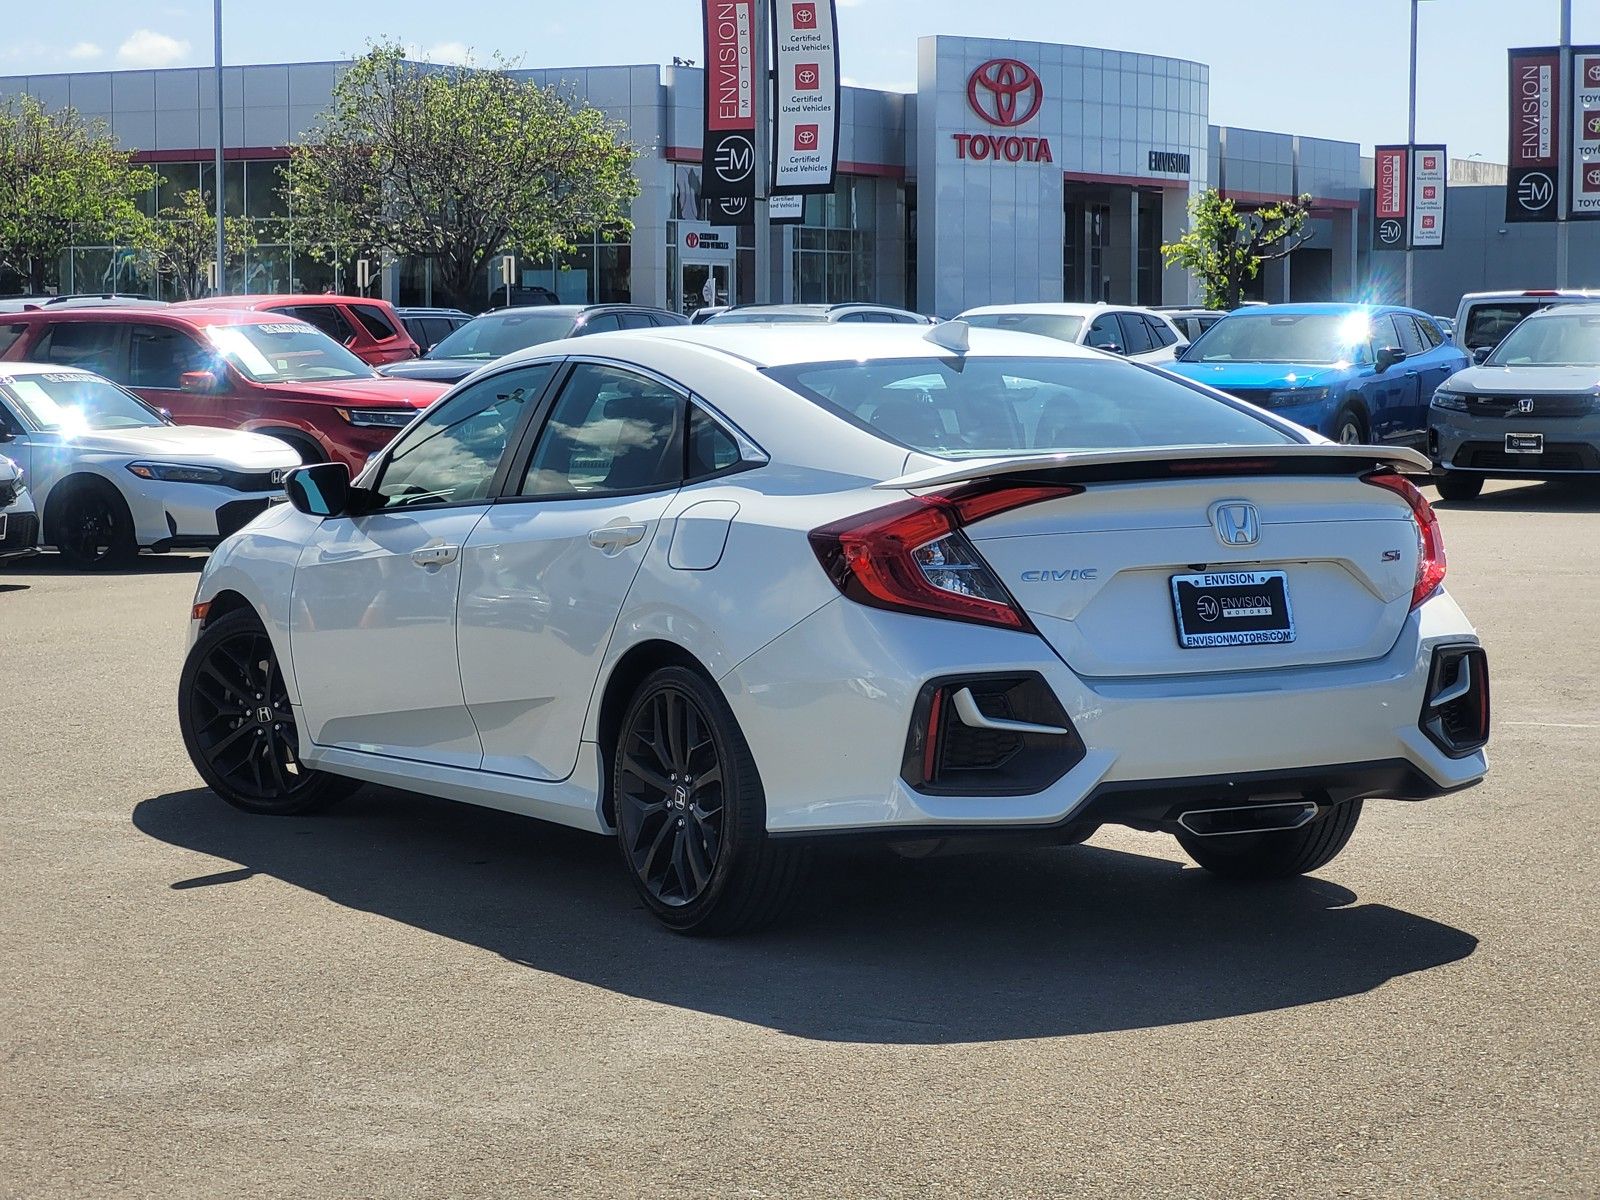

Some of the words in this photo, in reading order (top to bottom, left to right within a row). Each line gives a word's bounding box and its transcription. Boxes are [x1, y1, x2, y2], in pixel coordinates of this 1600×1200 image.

[790, 34, 821, 42] Certified
[801, 43, 830, 51] Vehicles
[717, 3, 737, 119] ENVISION
[739, 13, 749, 109] MOTORS
[791, 95, 823, 103] Certified
[802, 104, 831, 112] Vehicles
[1522, 65, 1539, 159] ENVISION
[953, 133, 1053, 163] TOYOTA
[800, 164, 828, 172] Vehicles
[1148, 150, 1191, 174] ENVISION
[1382, 155, 1393, 213] ENVISION
[1020, 568, 1098, 582] CIVIC
[1204, 573, 1255, 586] ENVISION
[1220, 595, 1272, 609] ENVISION
[1226, 608, 1269, 616] MOTORS
[1186, 631, 1292, 646] ENVISIONMOTORS.COM
